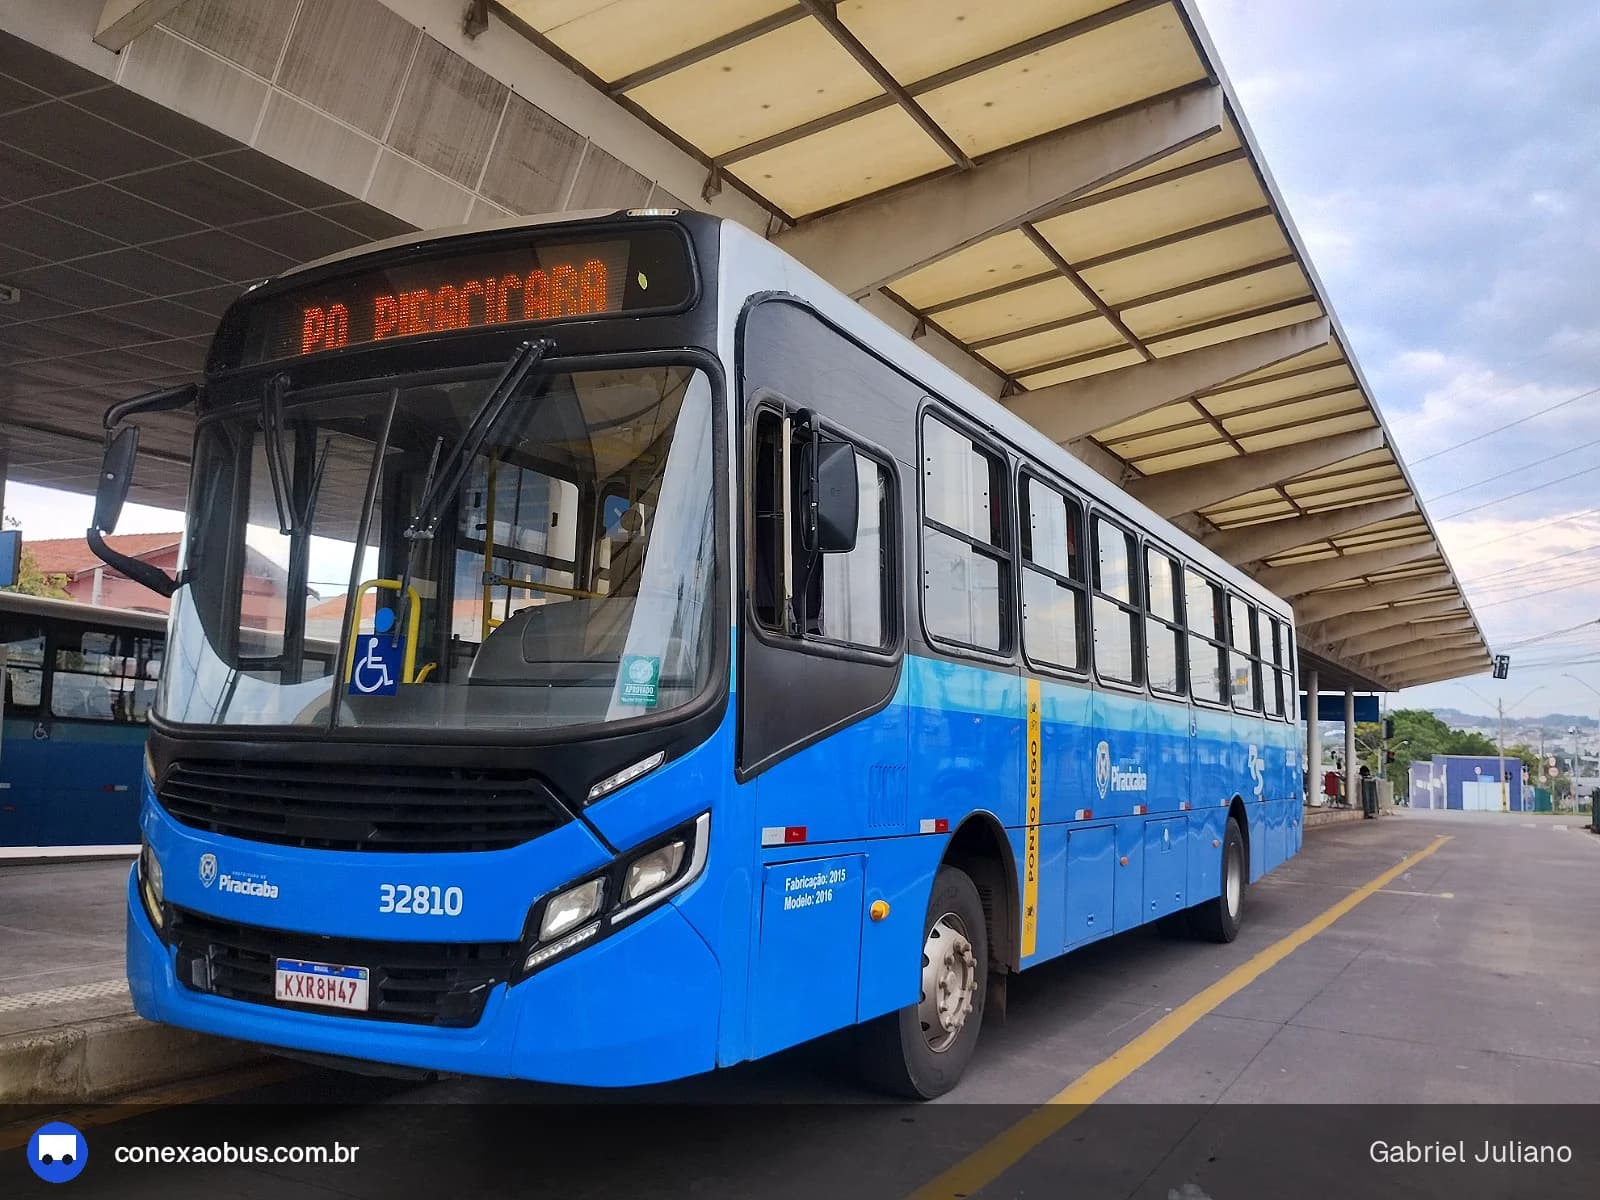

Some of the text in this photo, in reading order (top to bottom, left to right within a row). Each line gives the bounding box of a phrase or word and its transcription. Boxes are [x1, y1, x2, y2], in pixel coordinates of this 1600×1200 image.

[1111, 764, 1147, 792] Piracicaba
[1028, 806, 1036, 882] PONTO
[218, 874, 279, 899] Piracicaba
[785, 869, 846, 891] Fabricação: 2015
[379, 883, 464, 917] 32810
[784, 889, 833, 911] Modelo: 2016
[285, 974, 357, 1004] KXR8H47
